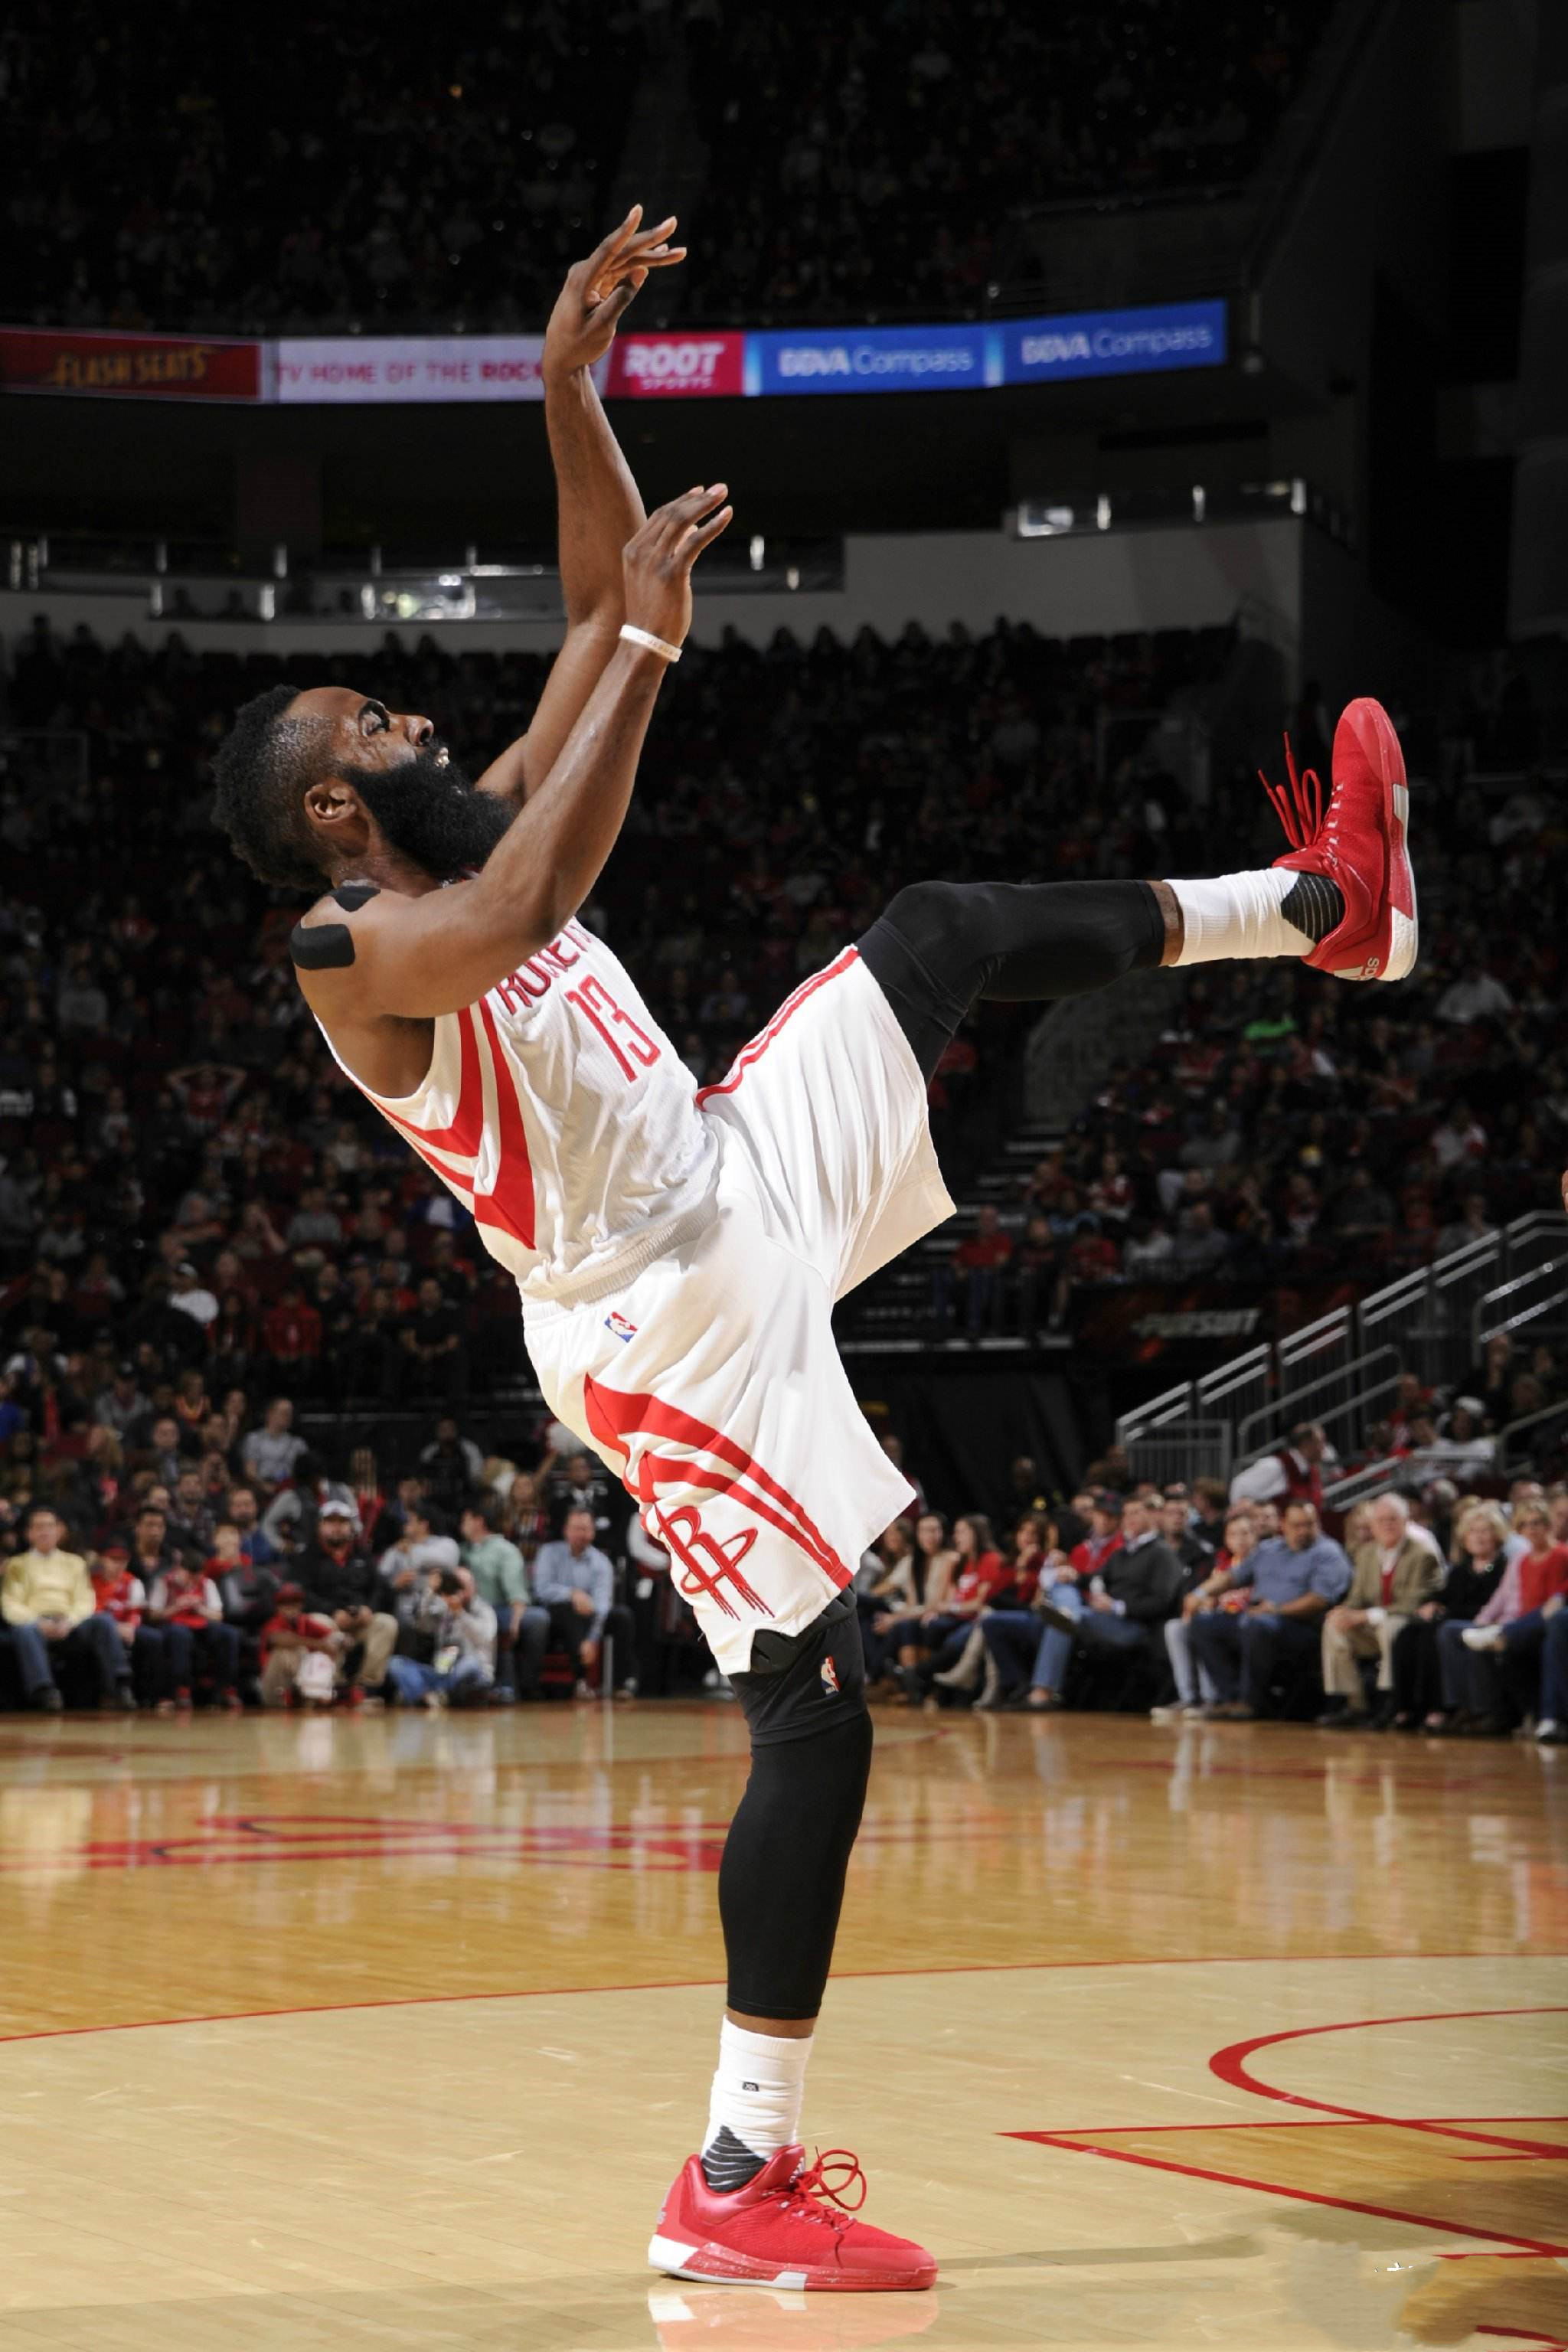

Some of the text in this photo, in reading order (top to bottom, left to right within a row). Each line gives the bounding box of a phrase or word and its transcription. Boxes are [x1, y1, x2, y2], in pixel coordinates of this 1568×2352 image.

[625, 341, 725, 377] ROOT
[1021, 323, 1211, 365] BBVA Compass
[276, 361, 302, 383] TV
[309, 362, 376, 383] HOME
[386, 361, 416, 383] OF
[426, 361, 470, 383] THE
[779, 346, 973, 377] BBVA Compass
[641, 377, 711, 390] SPORTS
[565, 974, 661, 1082] 13
